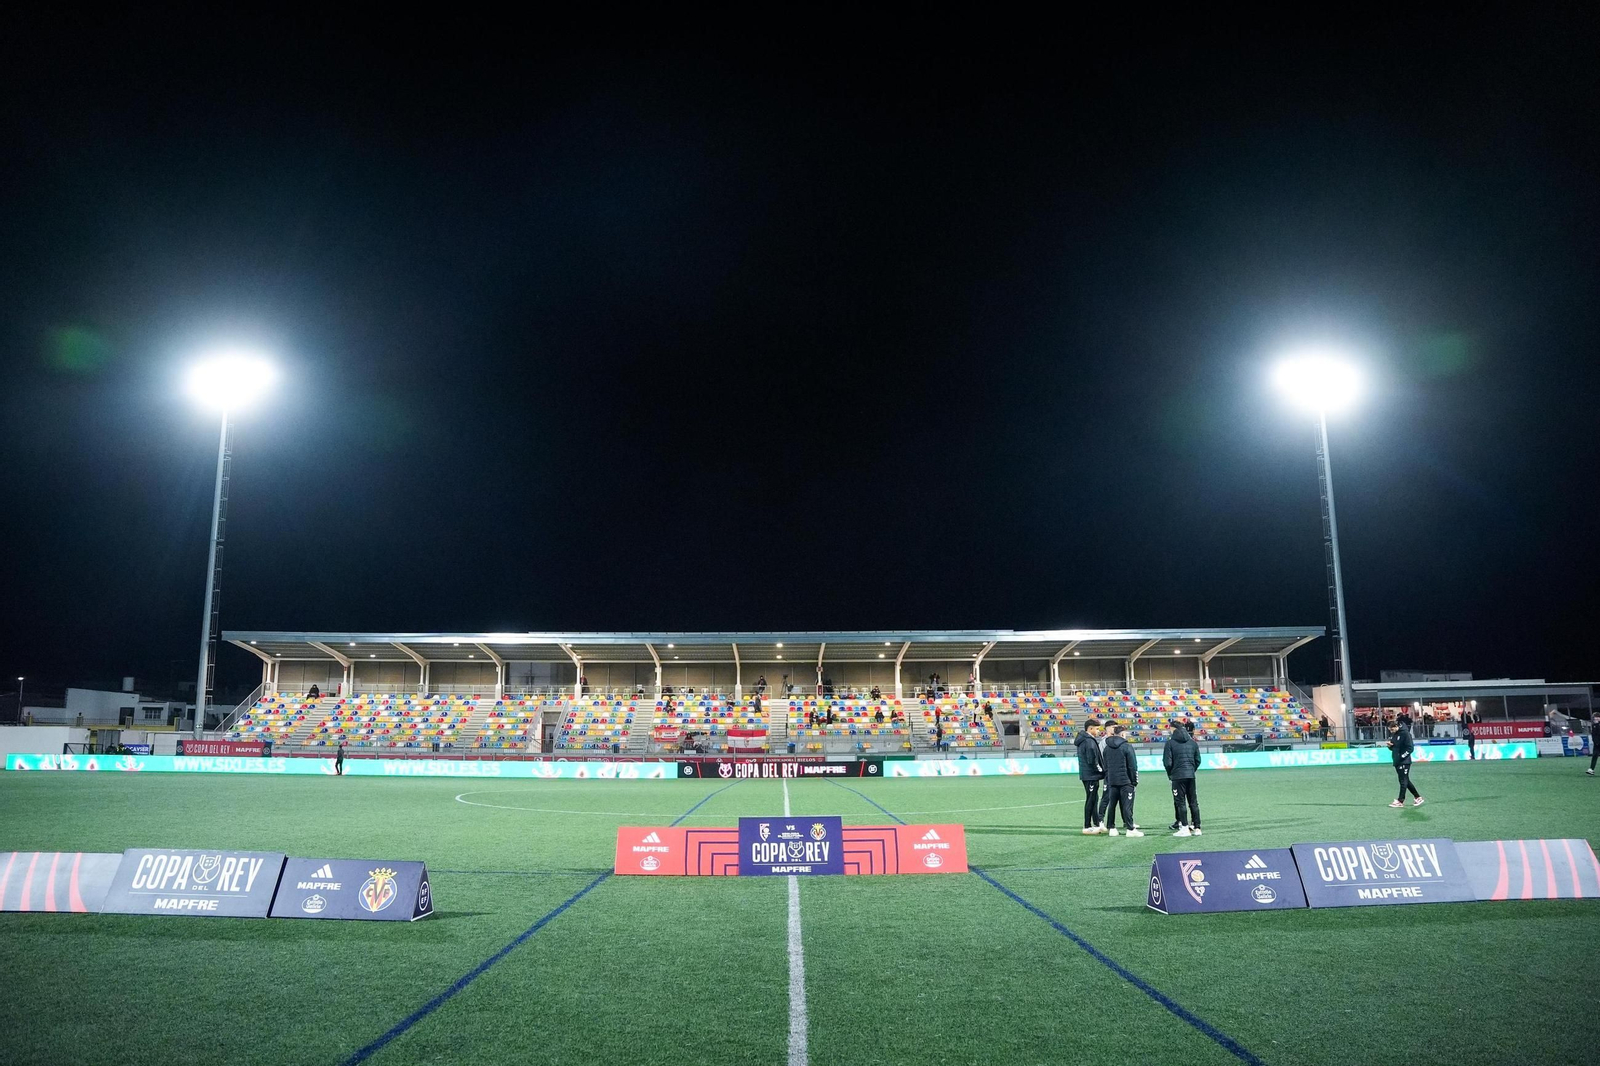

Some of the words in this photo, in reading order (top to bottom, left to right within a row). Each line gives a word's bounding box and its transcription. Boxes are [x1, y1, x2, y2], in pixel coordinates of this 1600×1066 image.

[1480, 726, 1493, 735] COPA
[1494, 726, 1503, 735] DEL
[1504, 726, 1513, 735] REY
[194, 744, 208, 754] COPA
[209, 744, 219, 754] DEL
[220, 745, 230, 754] REY
[735, 763, 759, 778] COPA
[763, 763, 778, 778] DEL
[782, 763, 798, 778] REY
[804, 766, 847, 774] MAPFRE
[752, 842, 787, 862] COPA
[806, 842, 829, 862] REY
[1314, 846, 1378, 882] COPA
[1397, 844, 1443, 878] REY
[132, 854, 193, 890] COPA
[216, 857, 264, 892] REY
[1236, 872, 1281, 881] MAPFRE
[297, 882, 342, 890] MAPFRE
[1358, 887, 1423, 899] MAPFRE
[154, 898, 219, 910] MAPFRE
